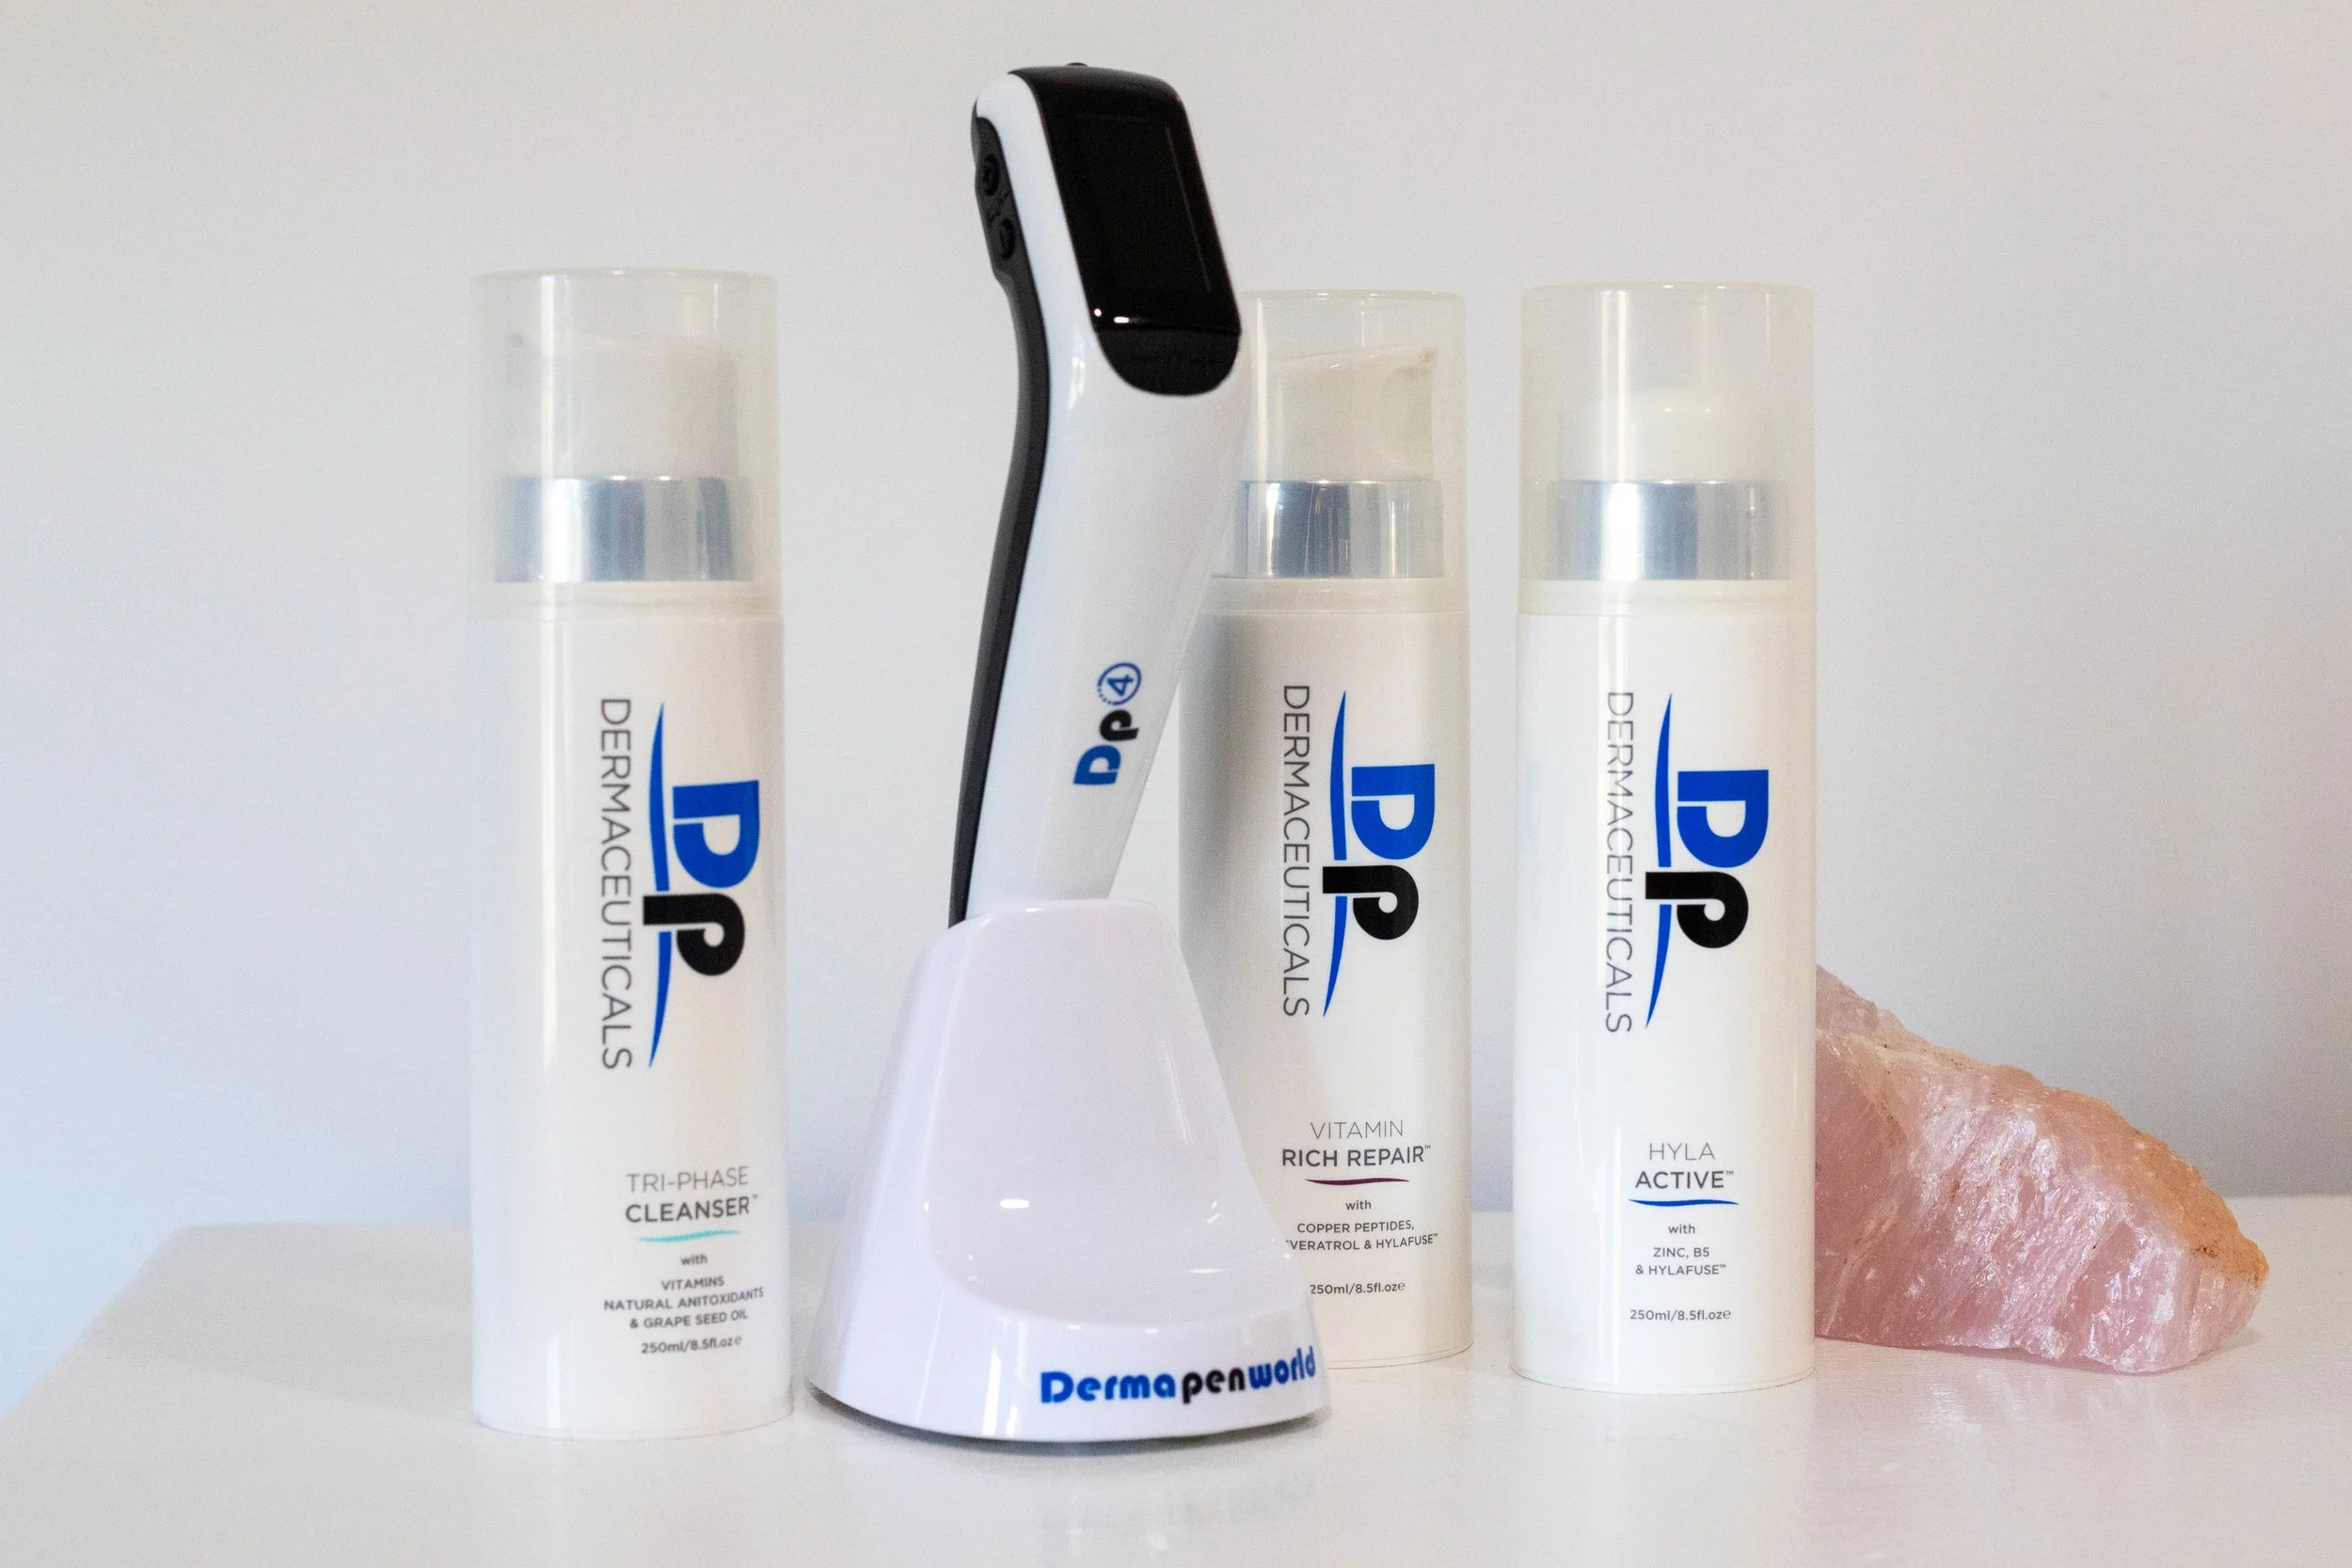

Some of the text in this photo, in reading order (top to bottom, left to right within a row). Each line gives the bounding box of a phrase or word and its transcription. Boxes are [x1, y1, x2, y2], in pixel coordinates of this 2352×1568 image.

[1282, 685, 1311, 1017] DERMACEUTICALS
[1605, 691, 1634, 1034] DERMACEUTICALS
[600, 698, 632, 1070] DERMACEUTICALS
[1310, 1119, 1404, 1140] VITAMIN
[1282, 1148, 1338, 1167] RICH
[1649, 1142, 1716, 1161] HYLA
[626, 1165, 750, 1194] TRI-PHASE
[1345, 1199, 1372, 1211] with
[1296, 1219, 1415, 1234] COPPER PEPTIDES,
[1668, 1223, 1695, 1235] with
[1285, 1239, 1360, 1251] VERATROL
[1363, 1240, 1373, 1250] &
[1653, 1247, 1710, 1259] ZINC, B5
[680, 1254, 708, 1266] with
[1635, 1264, 1645, 1275] &
[660, 1275, 725, 1291] VITAMINS
[603, 1299, 673, 1312] NATURAL
[629, 1308, 749, 1329] & GRAPE SEED OIL
